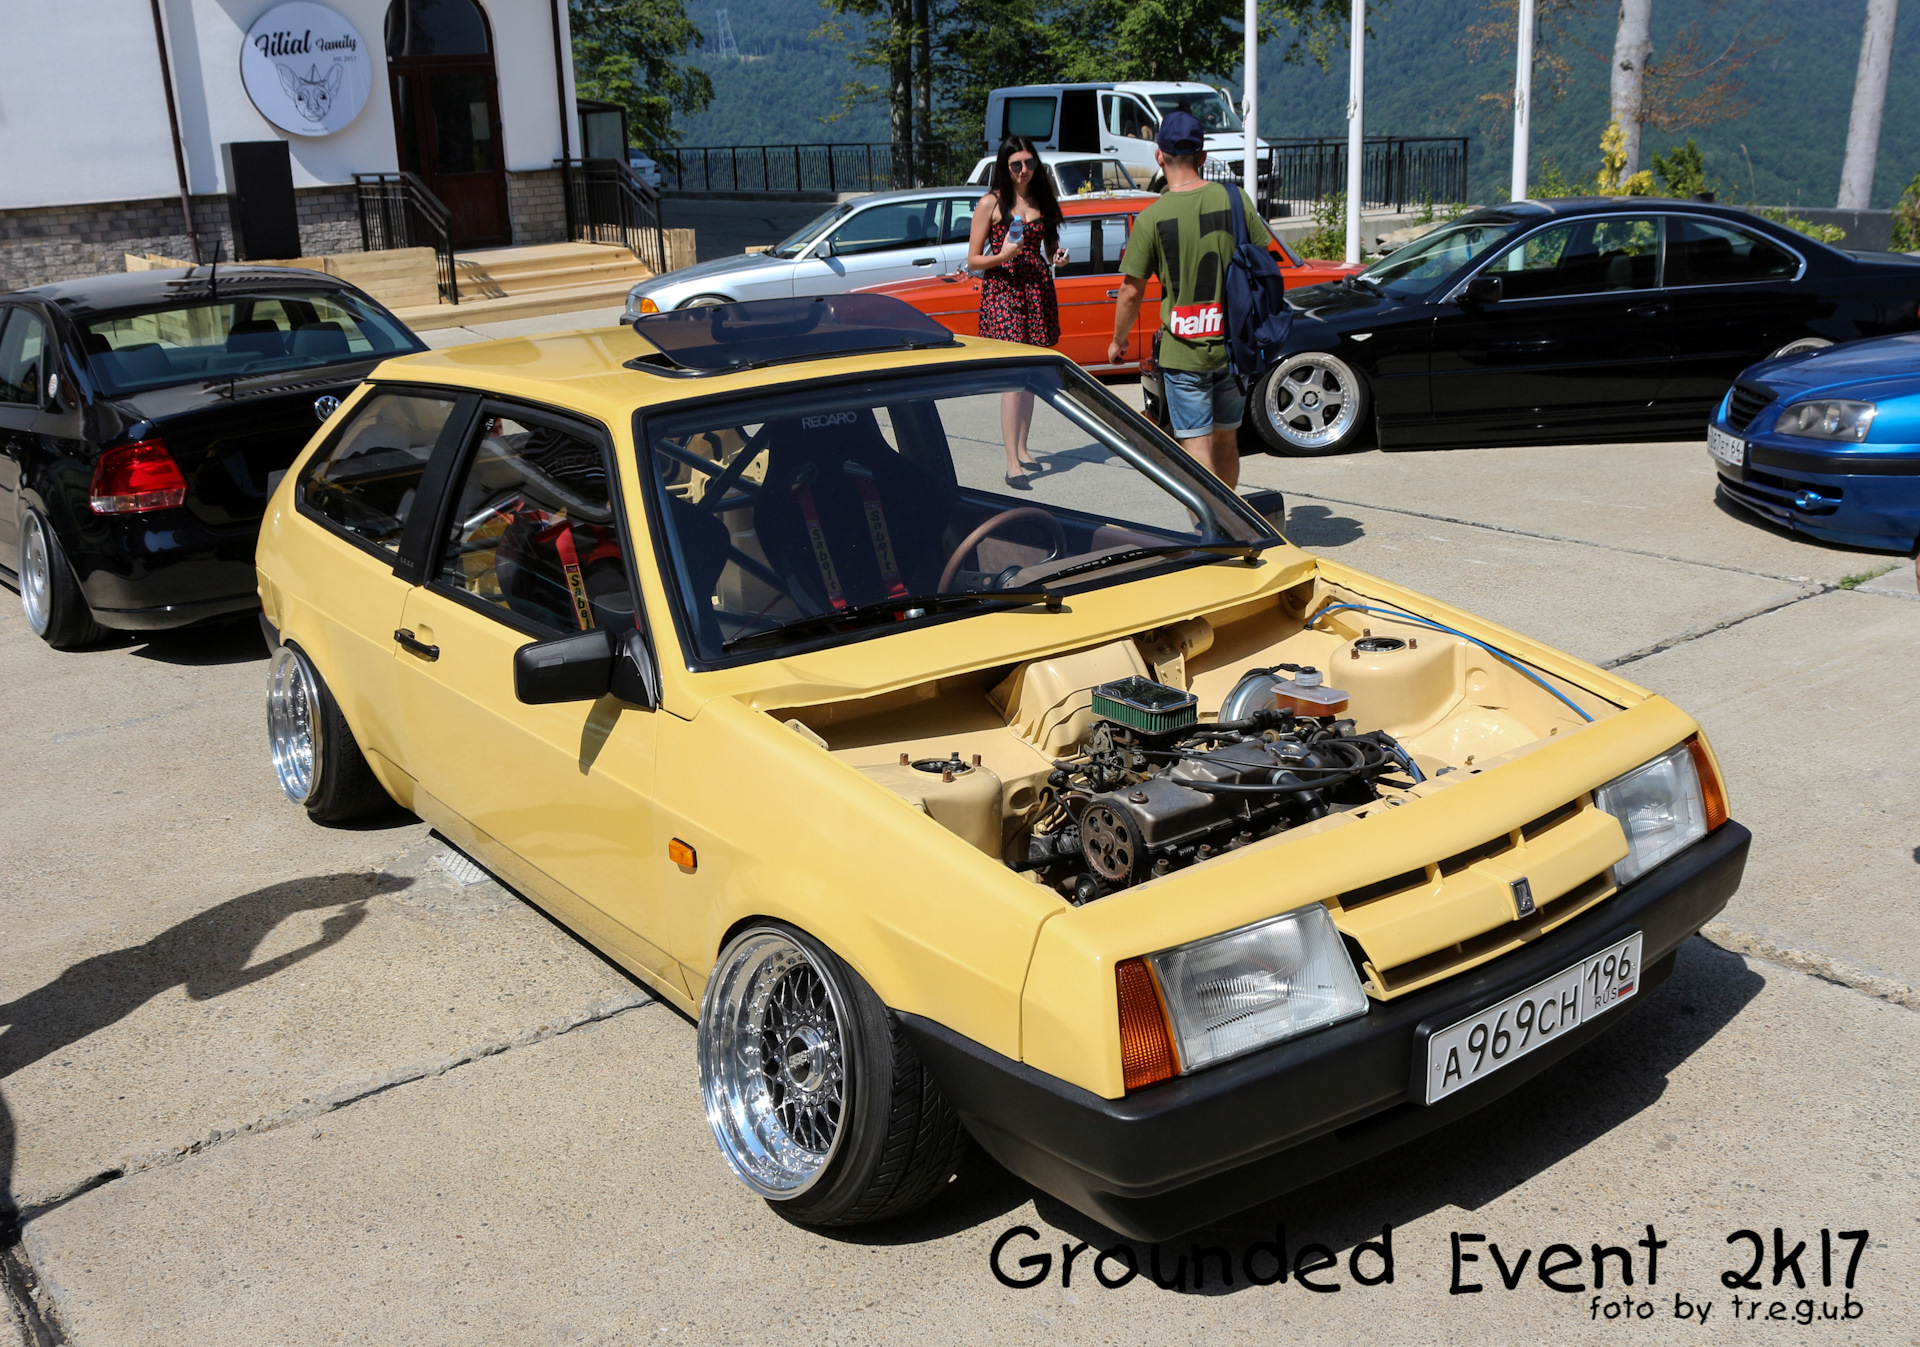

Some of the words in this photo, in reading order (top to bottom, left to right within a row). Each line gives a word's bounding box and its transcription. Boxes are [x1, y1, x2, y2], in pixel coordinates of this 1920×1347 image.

[254, 29, 311, 58] Filial
[315, 34, 357, 51] Family
[801, 411, 857, 429] RECARO
[812, 529, 837, 590] Sabelt
[870, 510, 892, 571] Sabelt
[1440, 984, 1577, 1089] A969CH
[1586, 944, 1631, 996] 196
[1594, 987, 1618, 1010] RUS
